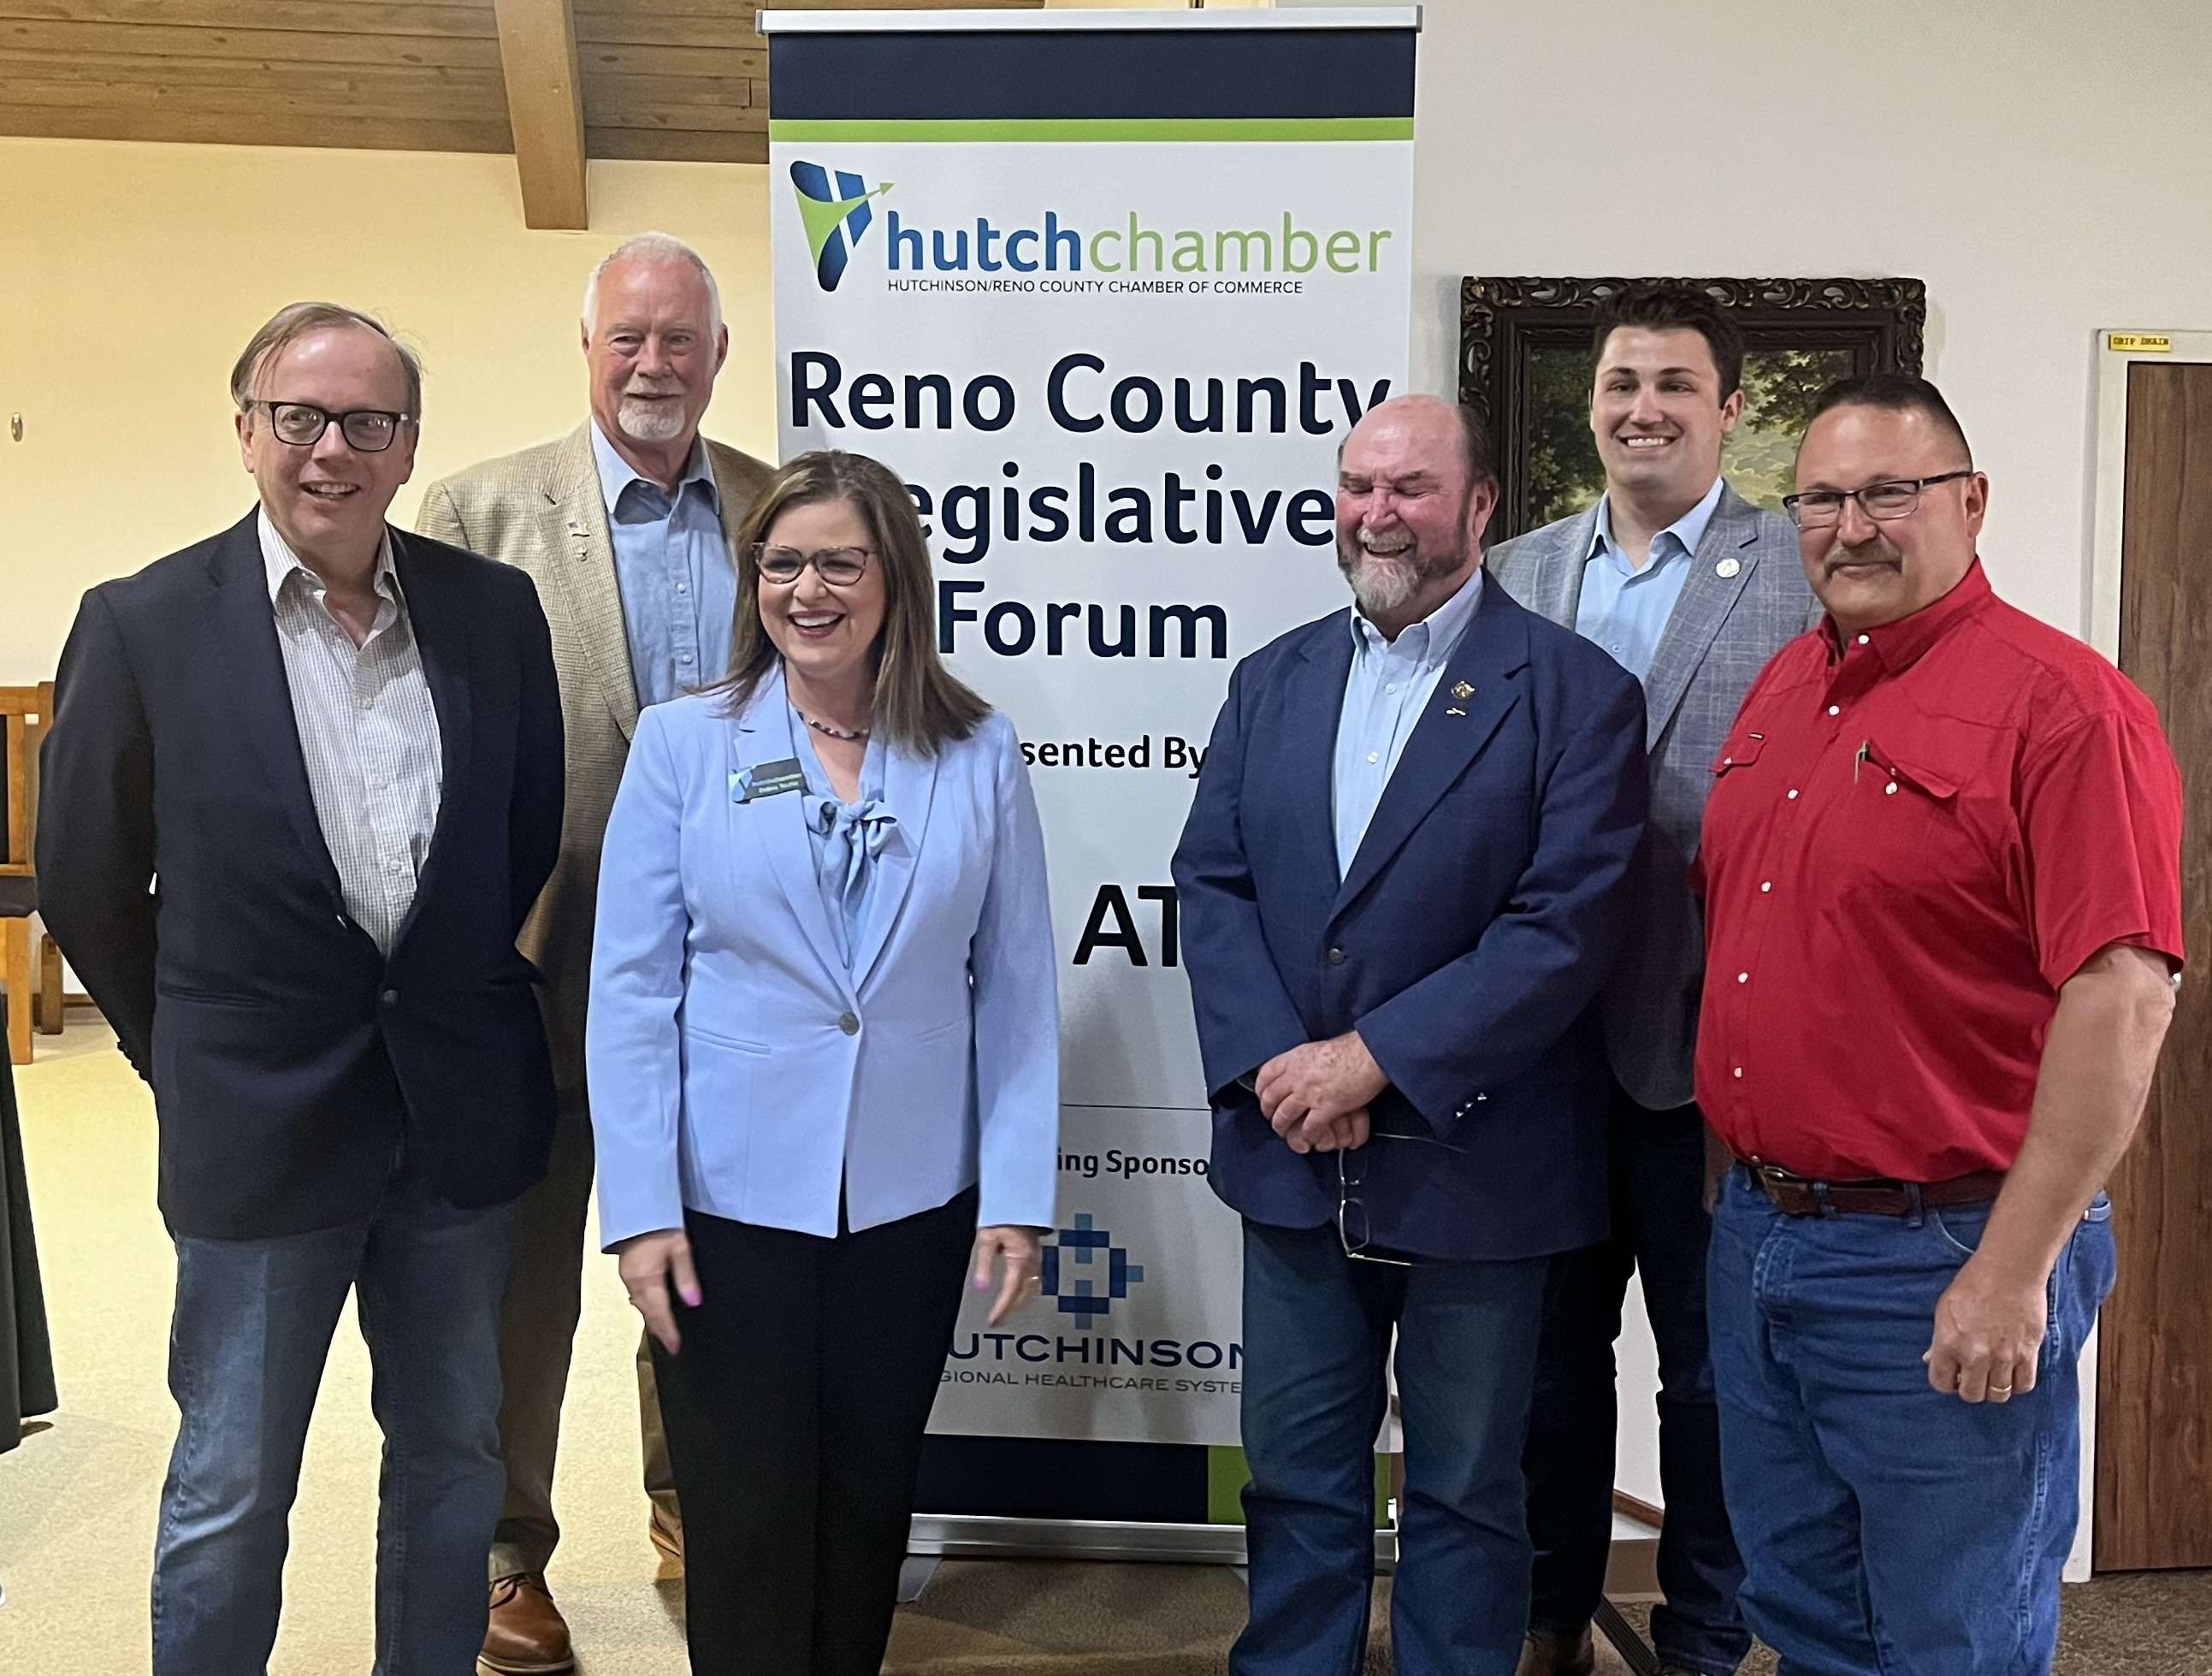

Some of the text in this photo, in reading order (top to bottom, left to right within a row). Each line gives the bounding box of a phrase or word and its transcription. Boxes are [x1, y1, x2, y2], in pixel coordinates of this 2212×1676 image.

[887, 210, 1393, 274] hutchchamber
[888, 279, 1304, 294] HUTCHINSON/RENO COUNTY CHAMBER OF COMMERCE
[791, 351, 1392, 435] Reno County
[903, 462, 1336, 565] egislative
[938, 580, 1228, 660] Forum
[1020, 734, 1210, 779] sented By
[1072, 884, 1178, 968] AT
[1056, 1147, 1210, 1180] ing Sponso
[948, 1333, 1244, 1371] UTCHINSON
[939, 1370, 1243, 1395] GIONAL HEALTHCARE SYSTE
